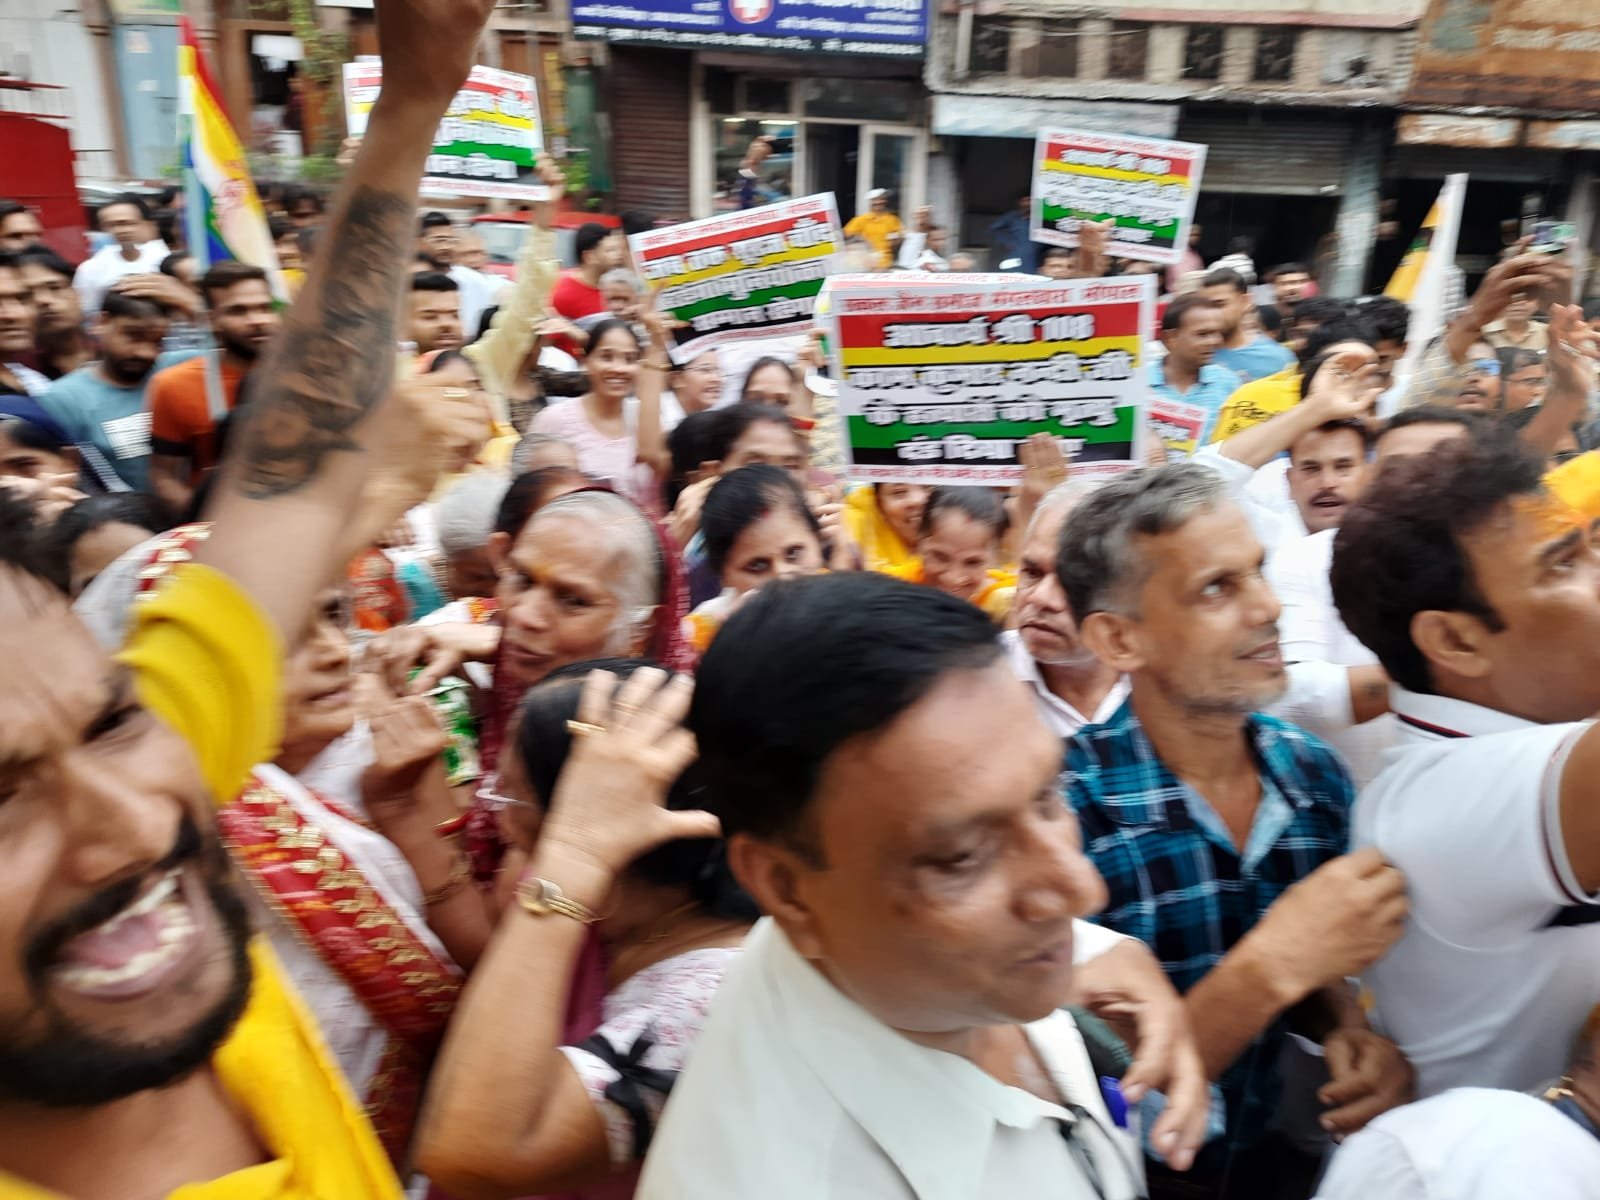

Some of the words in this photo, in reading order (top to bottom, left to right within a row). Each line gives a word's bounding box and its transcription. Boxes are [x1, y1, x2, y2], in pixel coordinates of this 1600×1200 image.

[882, 316, 991, 348] आचार्य
[992, 313, 1037, 344] श्री
[1038, 313, 1094, 341] 108
[1082, 349, 1133, 381] जी
